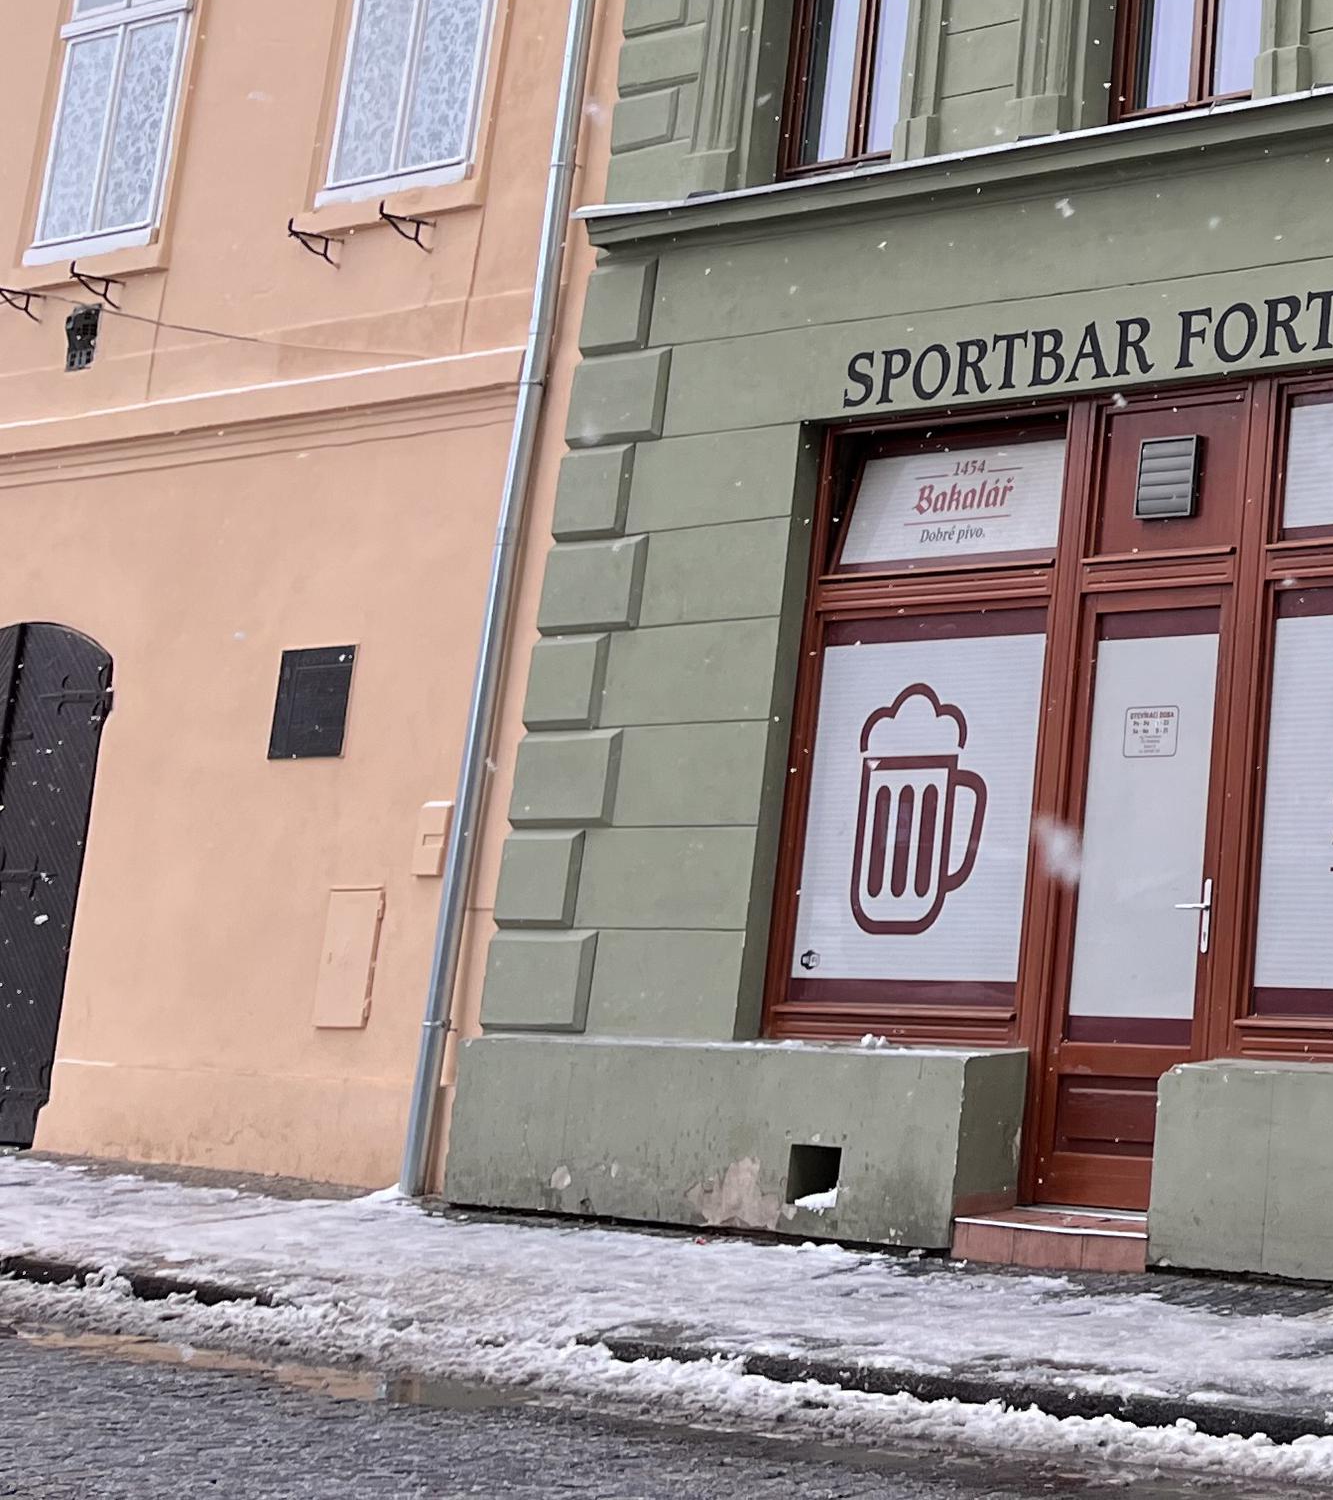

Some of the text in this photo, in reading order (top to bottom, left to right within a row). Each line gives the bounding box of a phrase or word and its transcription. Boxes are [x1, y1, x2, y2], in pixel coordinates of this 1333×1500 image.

[842, 316, 1155, 409] SPORTBAR
[952, 459, 987, 477] 1454
[911, 475, 1016, 516] Bakalář
[919, 524, 986, 544] Dobré pivo.
